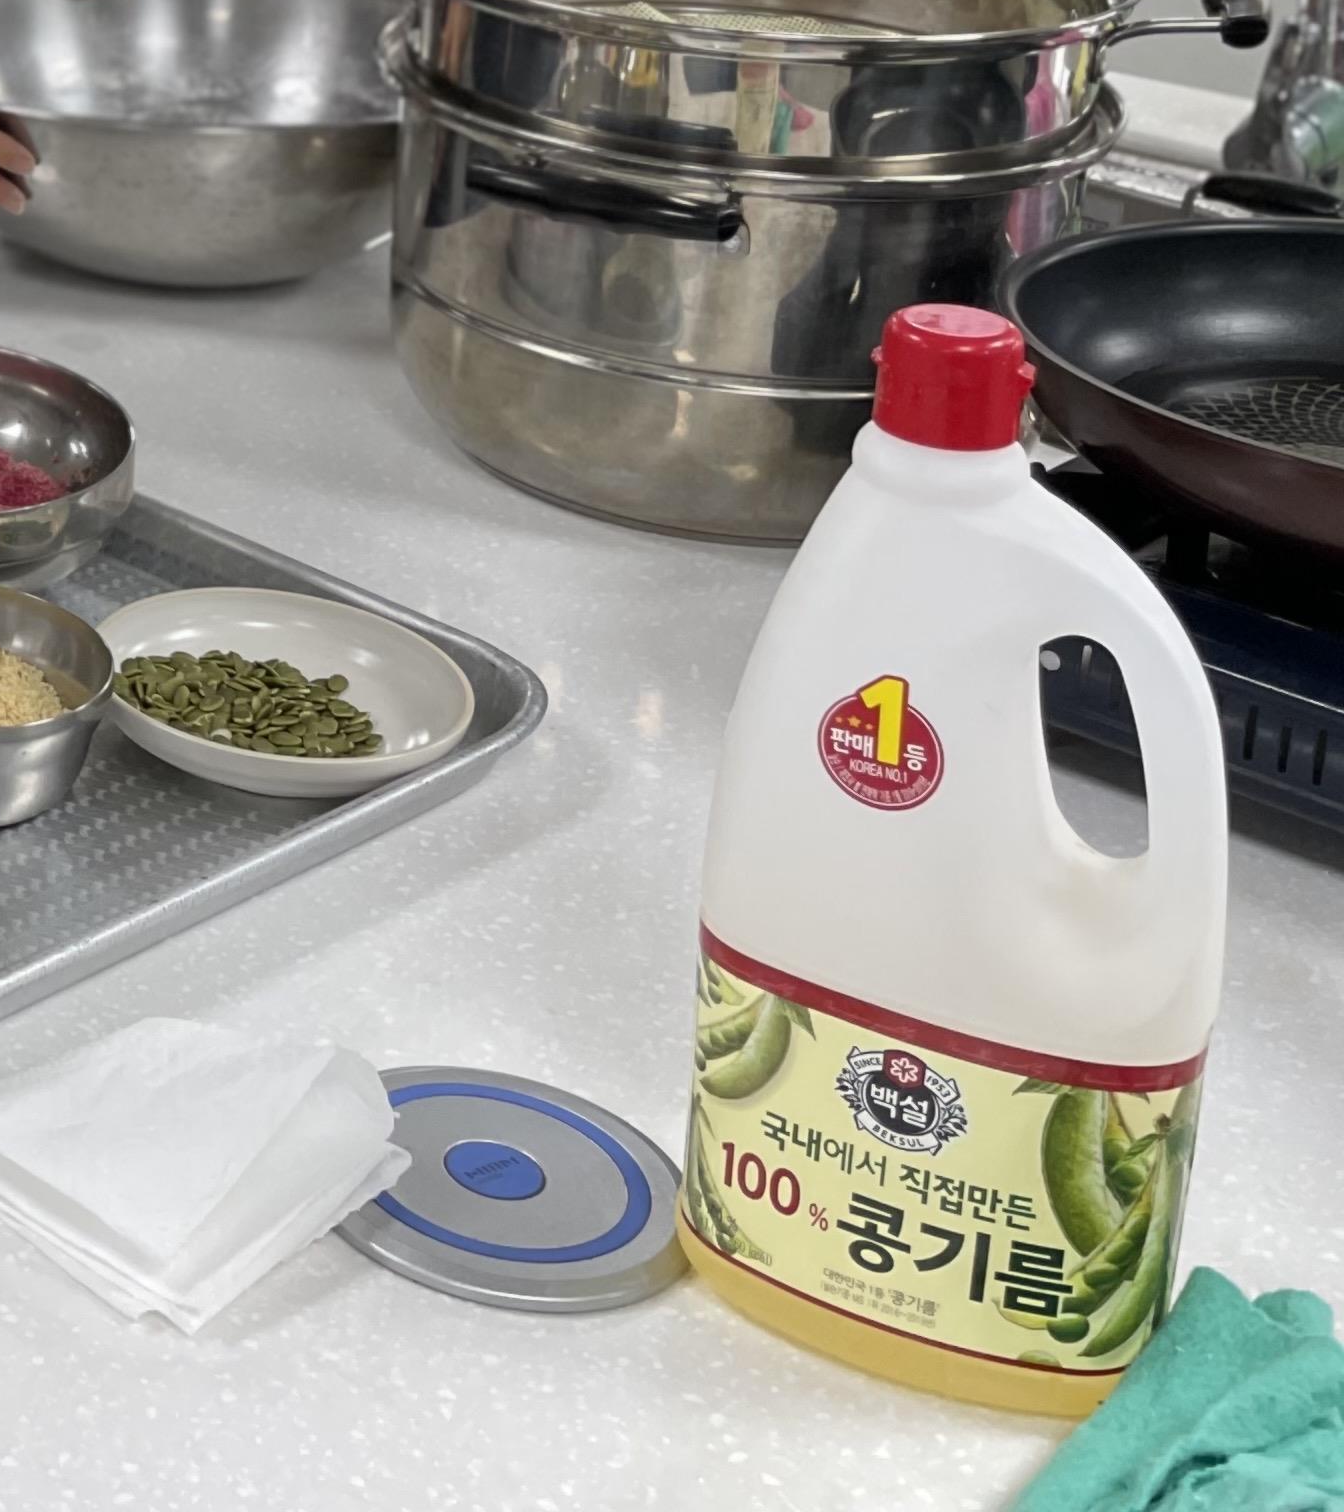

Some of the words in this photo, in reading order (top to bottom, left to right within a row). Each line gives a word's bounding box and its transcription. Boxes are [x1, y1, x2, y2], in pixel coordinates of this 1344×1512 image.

[830, 727, 874, 758] 판매
[849, 758, 883, 778] KOREA
[885, 768, 908, 784] NO.1
[853, 1057, 882, 1070] SINCE
[926, 1076, 951, 1098] 1953
[871, 1084, 929, 1128] 백설
[872, 1124, 925, 1148] BEKSUL
[761, 1111, 887, 1186] 국내에서
[899, 1164, 1036, 1232] 직접만든
[722, 1142, 801, 1217] 100
[836, 1192, 1074, 1319] 콩기름
[823, 1267, 866, 1292] 대한민국
